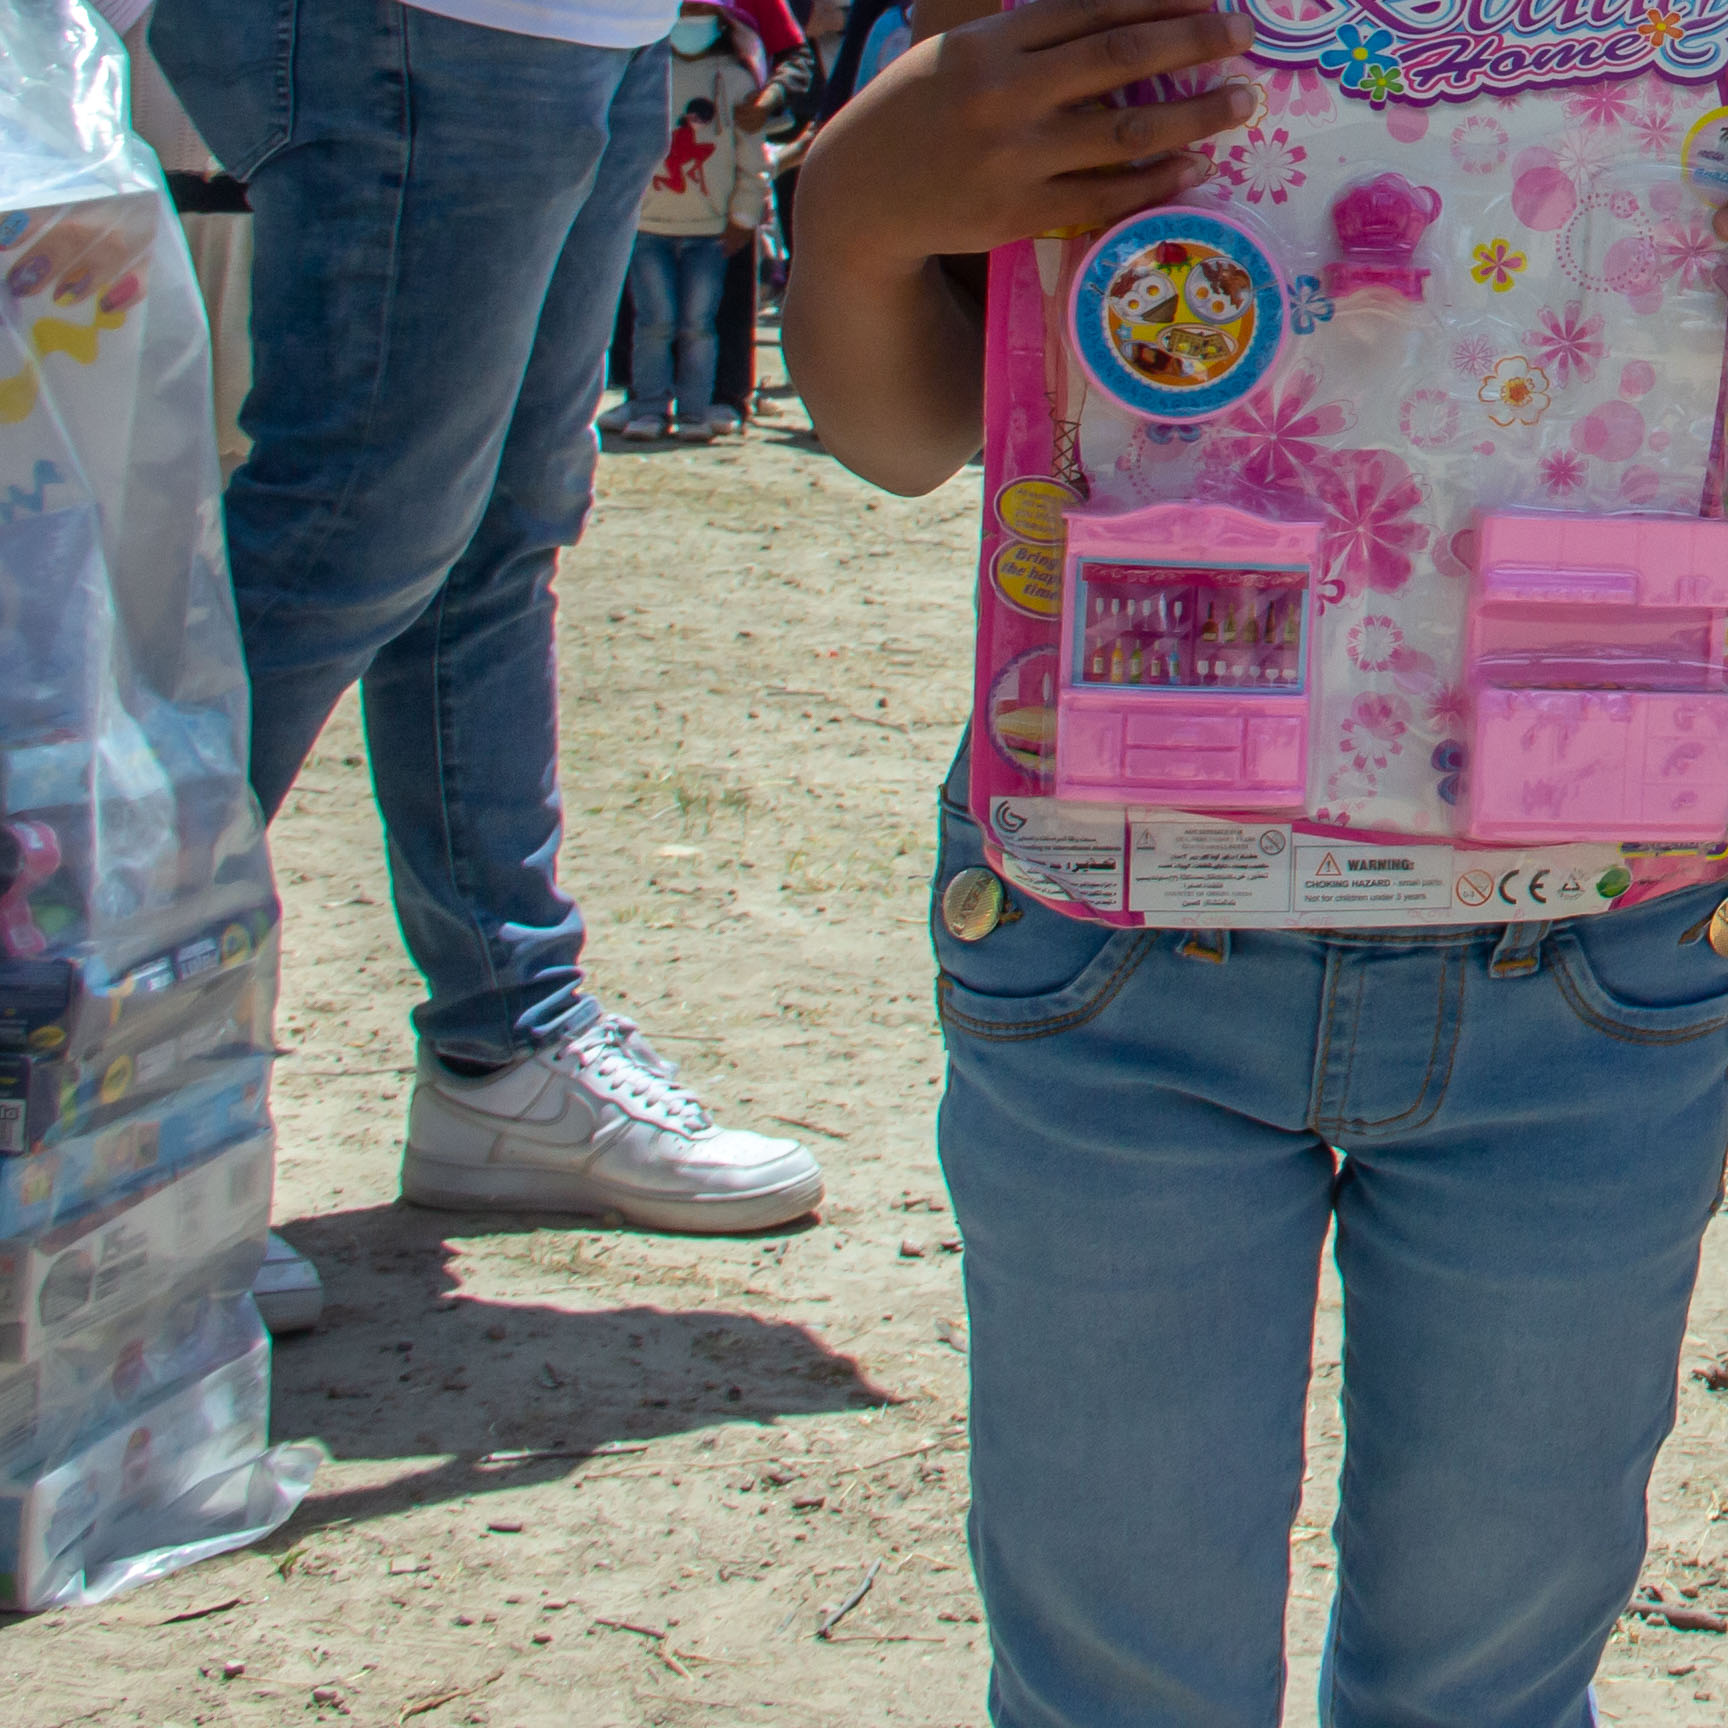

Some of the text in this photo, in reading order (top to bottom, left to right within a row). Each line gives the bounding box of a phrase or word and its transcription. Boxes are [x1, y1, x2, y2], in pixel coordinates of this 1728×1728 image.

[1414, 34, 1648, 82] Home
[1348, 858, 1415, 871] WARNING:
[1304, 878, 1349, 889] CHOKING
[1351, 878, 1391, 888] HAZARD
[1498, 869, 1552, 905] CE
